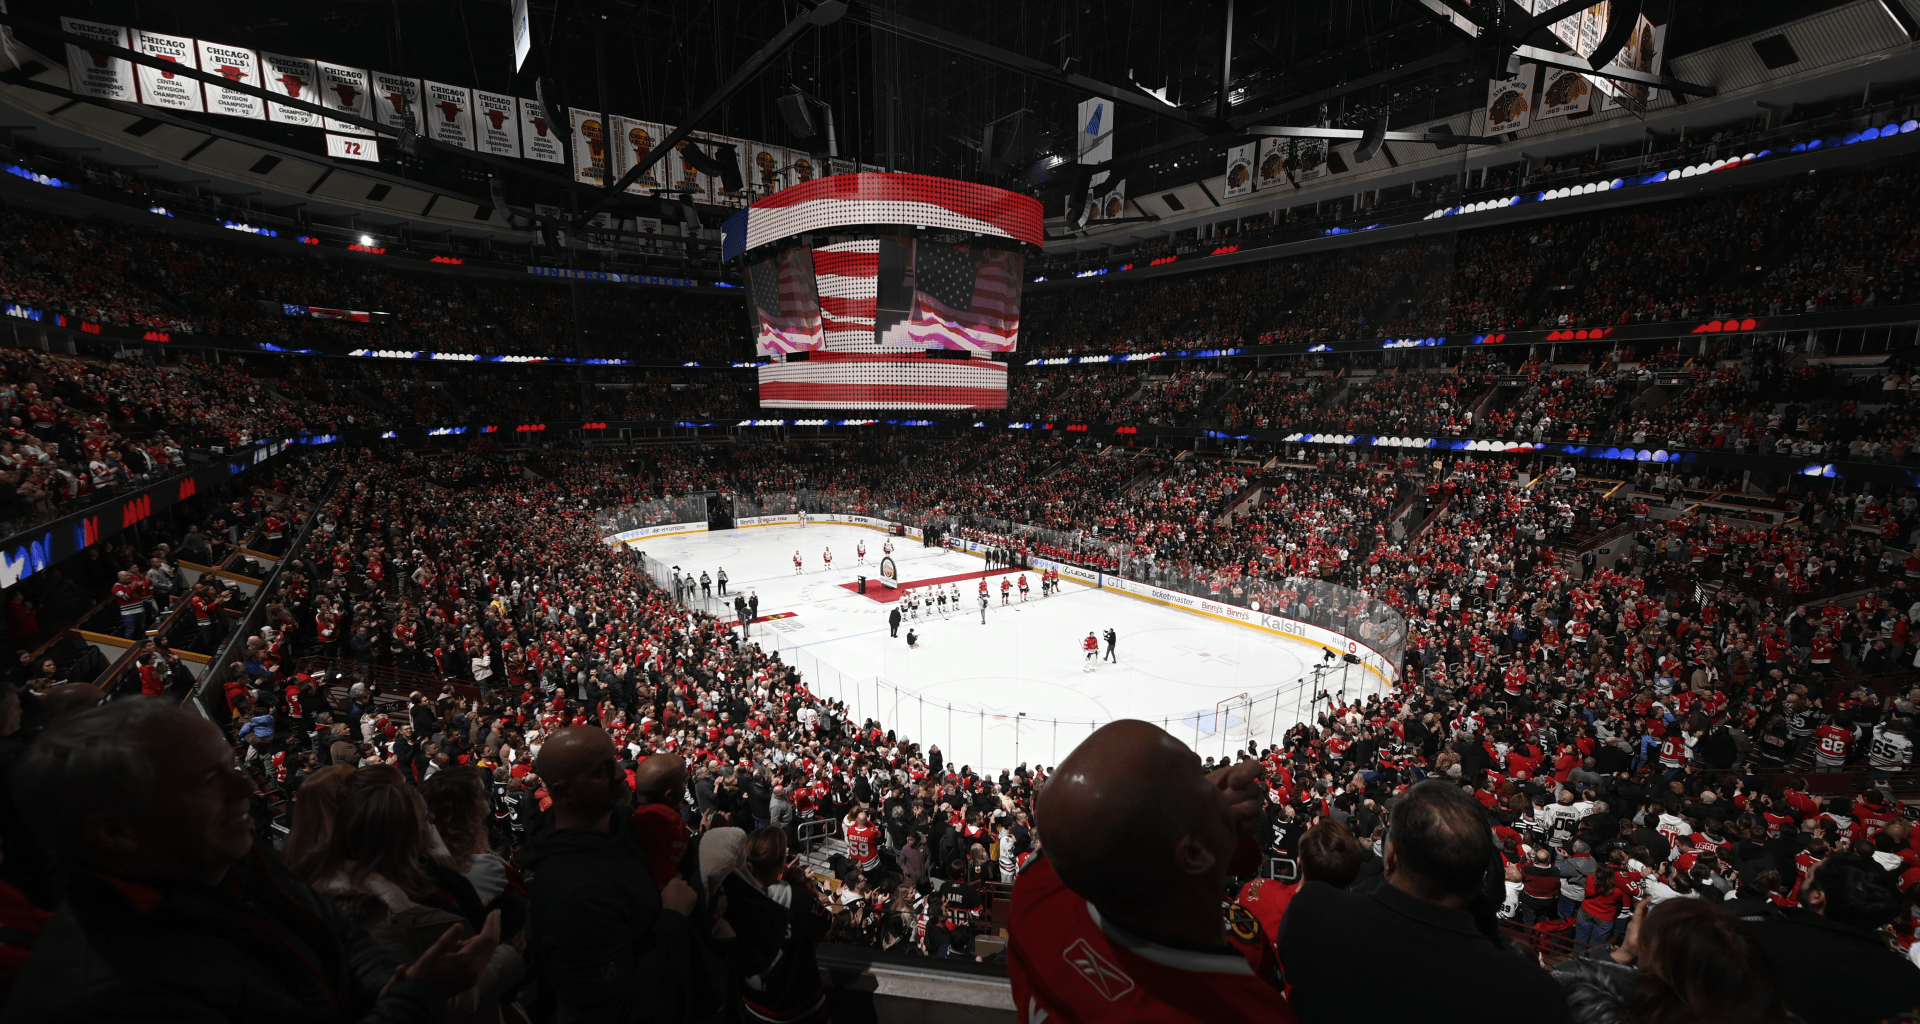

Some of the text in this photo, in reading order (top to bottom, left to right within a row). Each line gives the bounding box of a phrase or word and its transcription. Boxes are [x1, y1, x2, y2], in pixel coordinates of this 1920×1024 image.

[70, 22, 118, 37] CHICAGO
[140, 35, 186, 48] CHICAGO
[150, 45, 180, 56] BULLS
[207, 47, 249, 60] CHICAGO
[215, 56, 245, 67] BULLS
[269, 57, 309, 70] CHICAGO
[88, 68, 116, 76] MIDWEST
[276, 66, 306, 76] BULLS
[325, 67, 362, 79] CHICAGO
[88, 74, 118, 83] DIVISION
[332, 76, 358, 86] BULLS
[380, 77, 415, 88] CHICAGO
[84, 80, 124, 90] CHAMPIONS
[157, 85, 185, 93] DIVISION
[386, 85, 410, 94] BULS
[1493, 82, 1527, 98] STAN MIKITA
[90, 88, 120, 97] 1974-75
[153, 91, 190, 100] CHAMPIONS
[431, 85, 464, 97] CHICAGO
[160, 98, 186, 106] 1990-91
[437, 94, 461, 103] BULLS
[479, 94, 510, 105] CHICAGO
[218, 100, 253, 109] CHAMPIONS
[485, 102, 506, 111] BULLS
[525, 102, 542, 110] CHIC
[1546, 104, 1579, 115] 1969-1984
[224, 107, 249, 115] 1991-92
[279, 108, 312, 117] CHAMPIONS
[441, 128, 462, 136] DIVISION
[1490, 121, 1521, 132] 1959-1980
[438, 133, 466, 142] CHAMPIONS
[1273, 139, 1277, 147] 9
[344, 141, 361, 156] 72
[486, 140, 512, 148] CHAMPIONS
[531, 146, 556, 154] CHAMPIONS
[534, 266, 692, 288] UNITED CENTER
[1070, 570, 1096, 580] LEXUS
[1108, 577, 1126, 589] GTL
[1152, 590, 1194, 605] ticketmaster
[1202, 601, 1223, 614] Binny's
[1227, 608, 1250, 620] Binny's
[1261, 613, 1306, 636] Kalshi
[1332, 637, 1347, 648] BMO
[1821, 738, 1845, 754] 88
[1872, 739, 1898, 759] 65
[849, 834, 868, 842] BERTUZZI
[1274, 830, 1284, 846] 7
[850, 841, 870, 857] 59
[1626, 881, 1638, 891] 19
[948, 893, 963, 904] KANE
